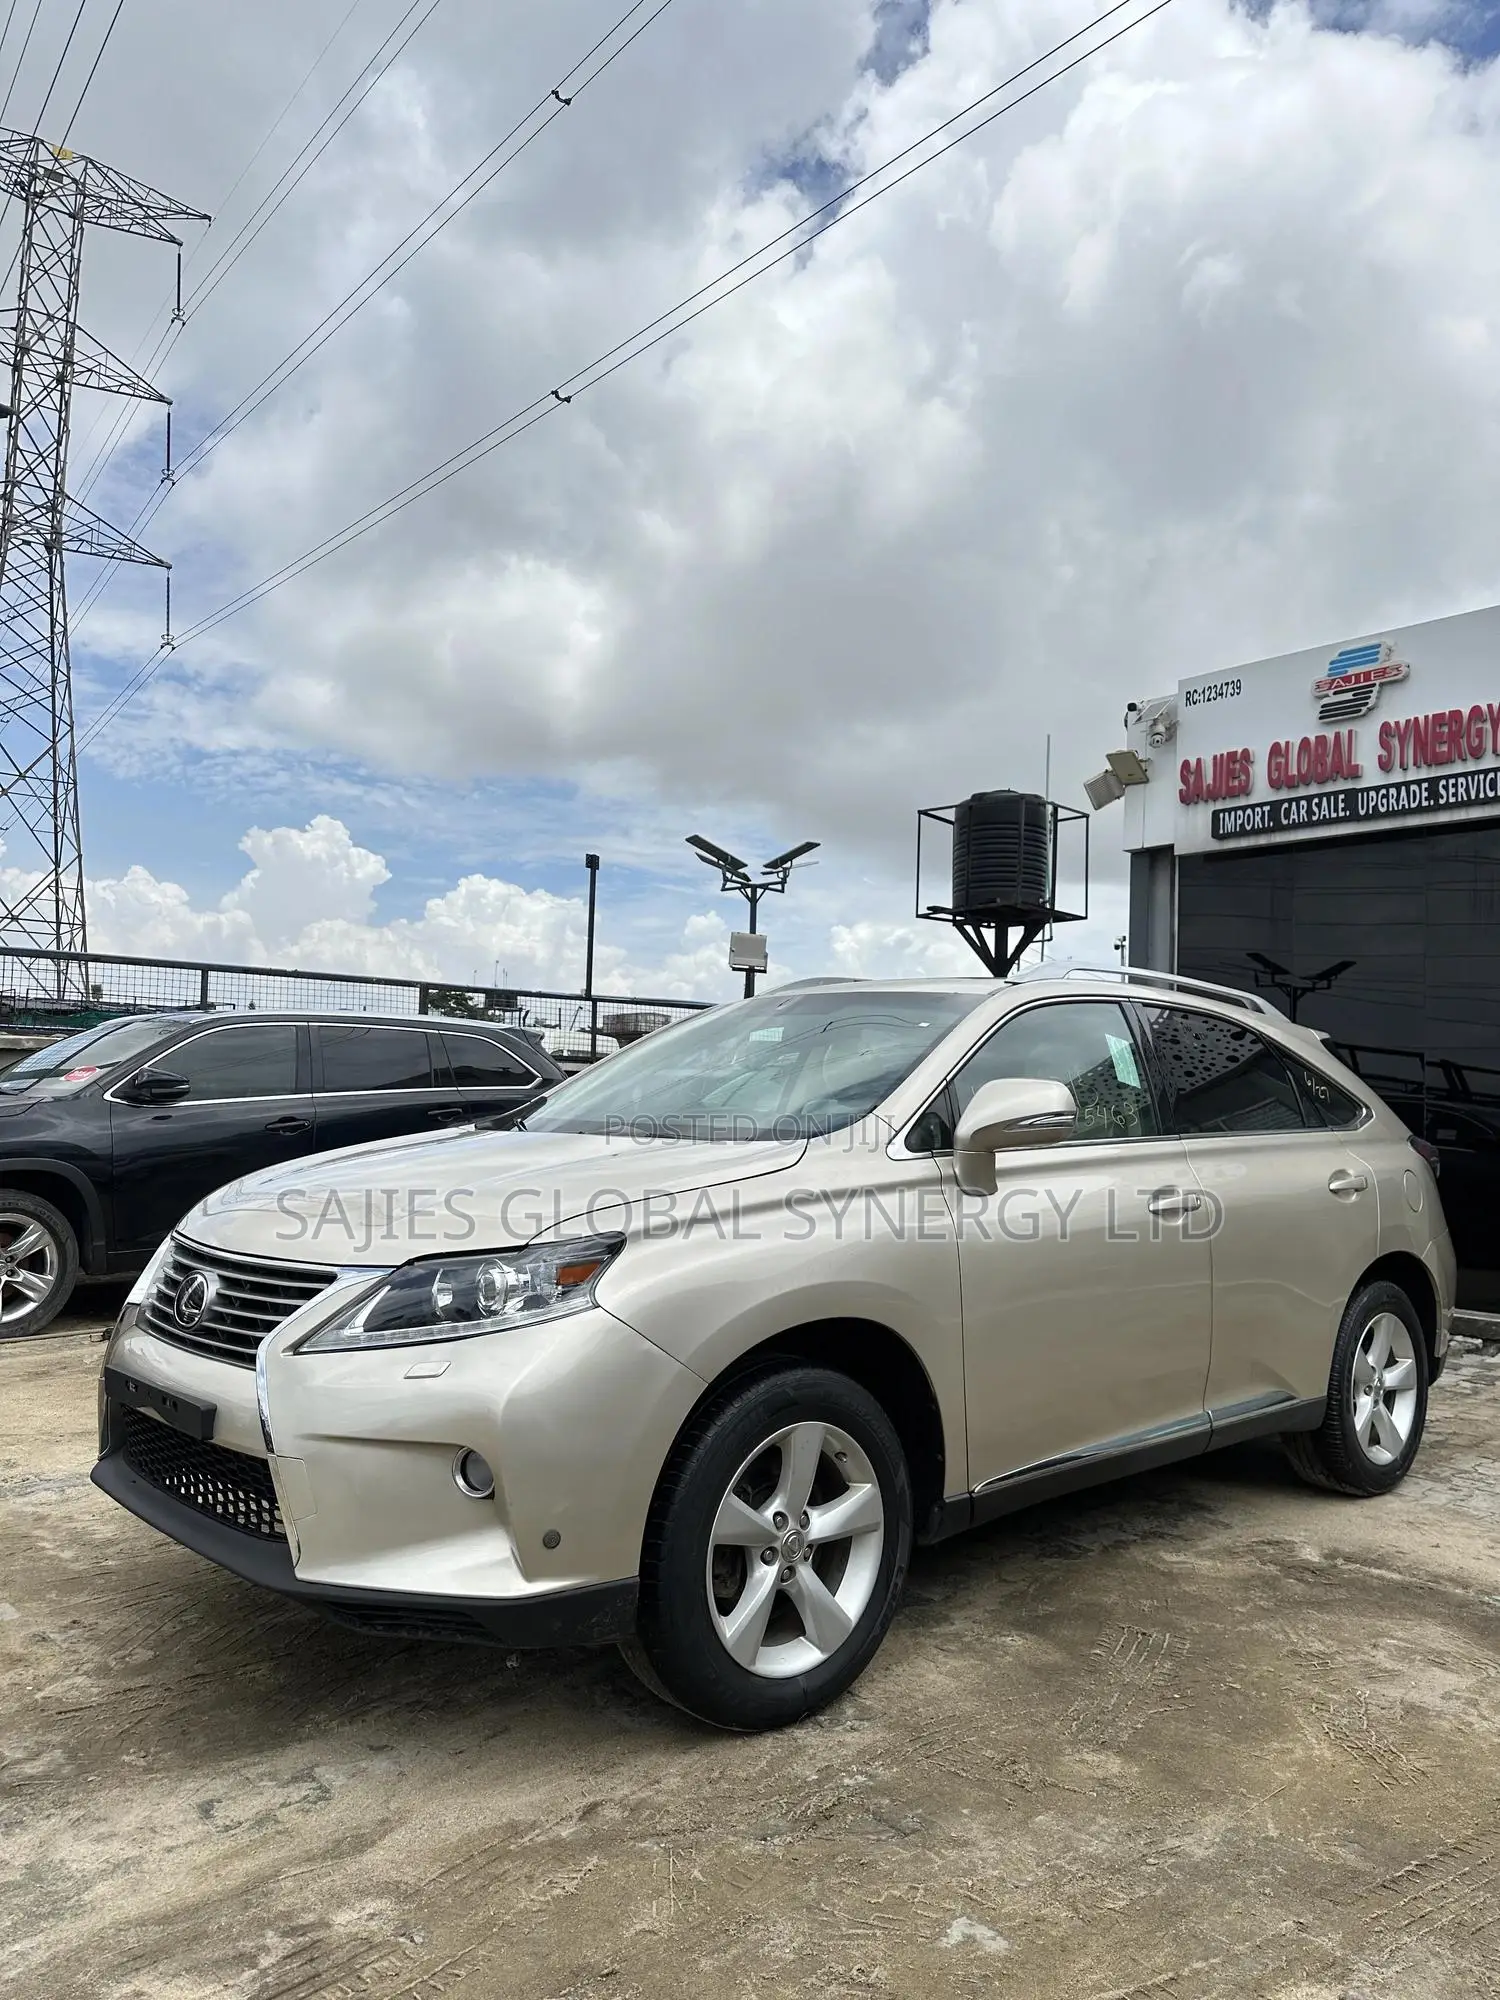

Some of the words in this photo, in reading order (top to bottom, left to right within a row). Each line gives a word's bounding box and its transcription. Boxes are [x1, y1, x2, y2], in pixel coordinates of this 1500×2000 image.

[1185, 679, 1242, 707] RC:1234739
[1314, 663, 1404, 693] SAJIES
[1179, 748, 1254, 805] SAJIES
[1267, 729, 1361, 789] GLOBAL
[1378, 702, 1500, 773] SYNERGY
[1219, 806, 1273, 834] IMPORT.
[1281, 800, 1308, 825] CAR
[1311, 794, 1350, 821] SALE.
[1358, 782, 1434, 816] UPGRADE.
[1438, 771, 1500, 805] SERVIC
[1084, 1102, 1138, 1129] 5463
